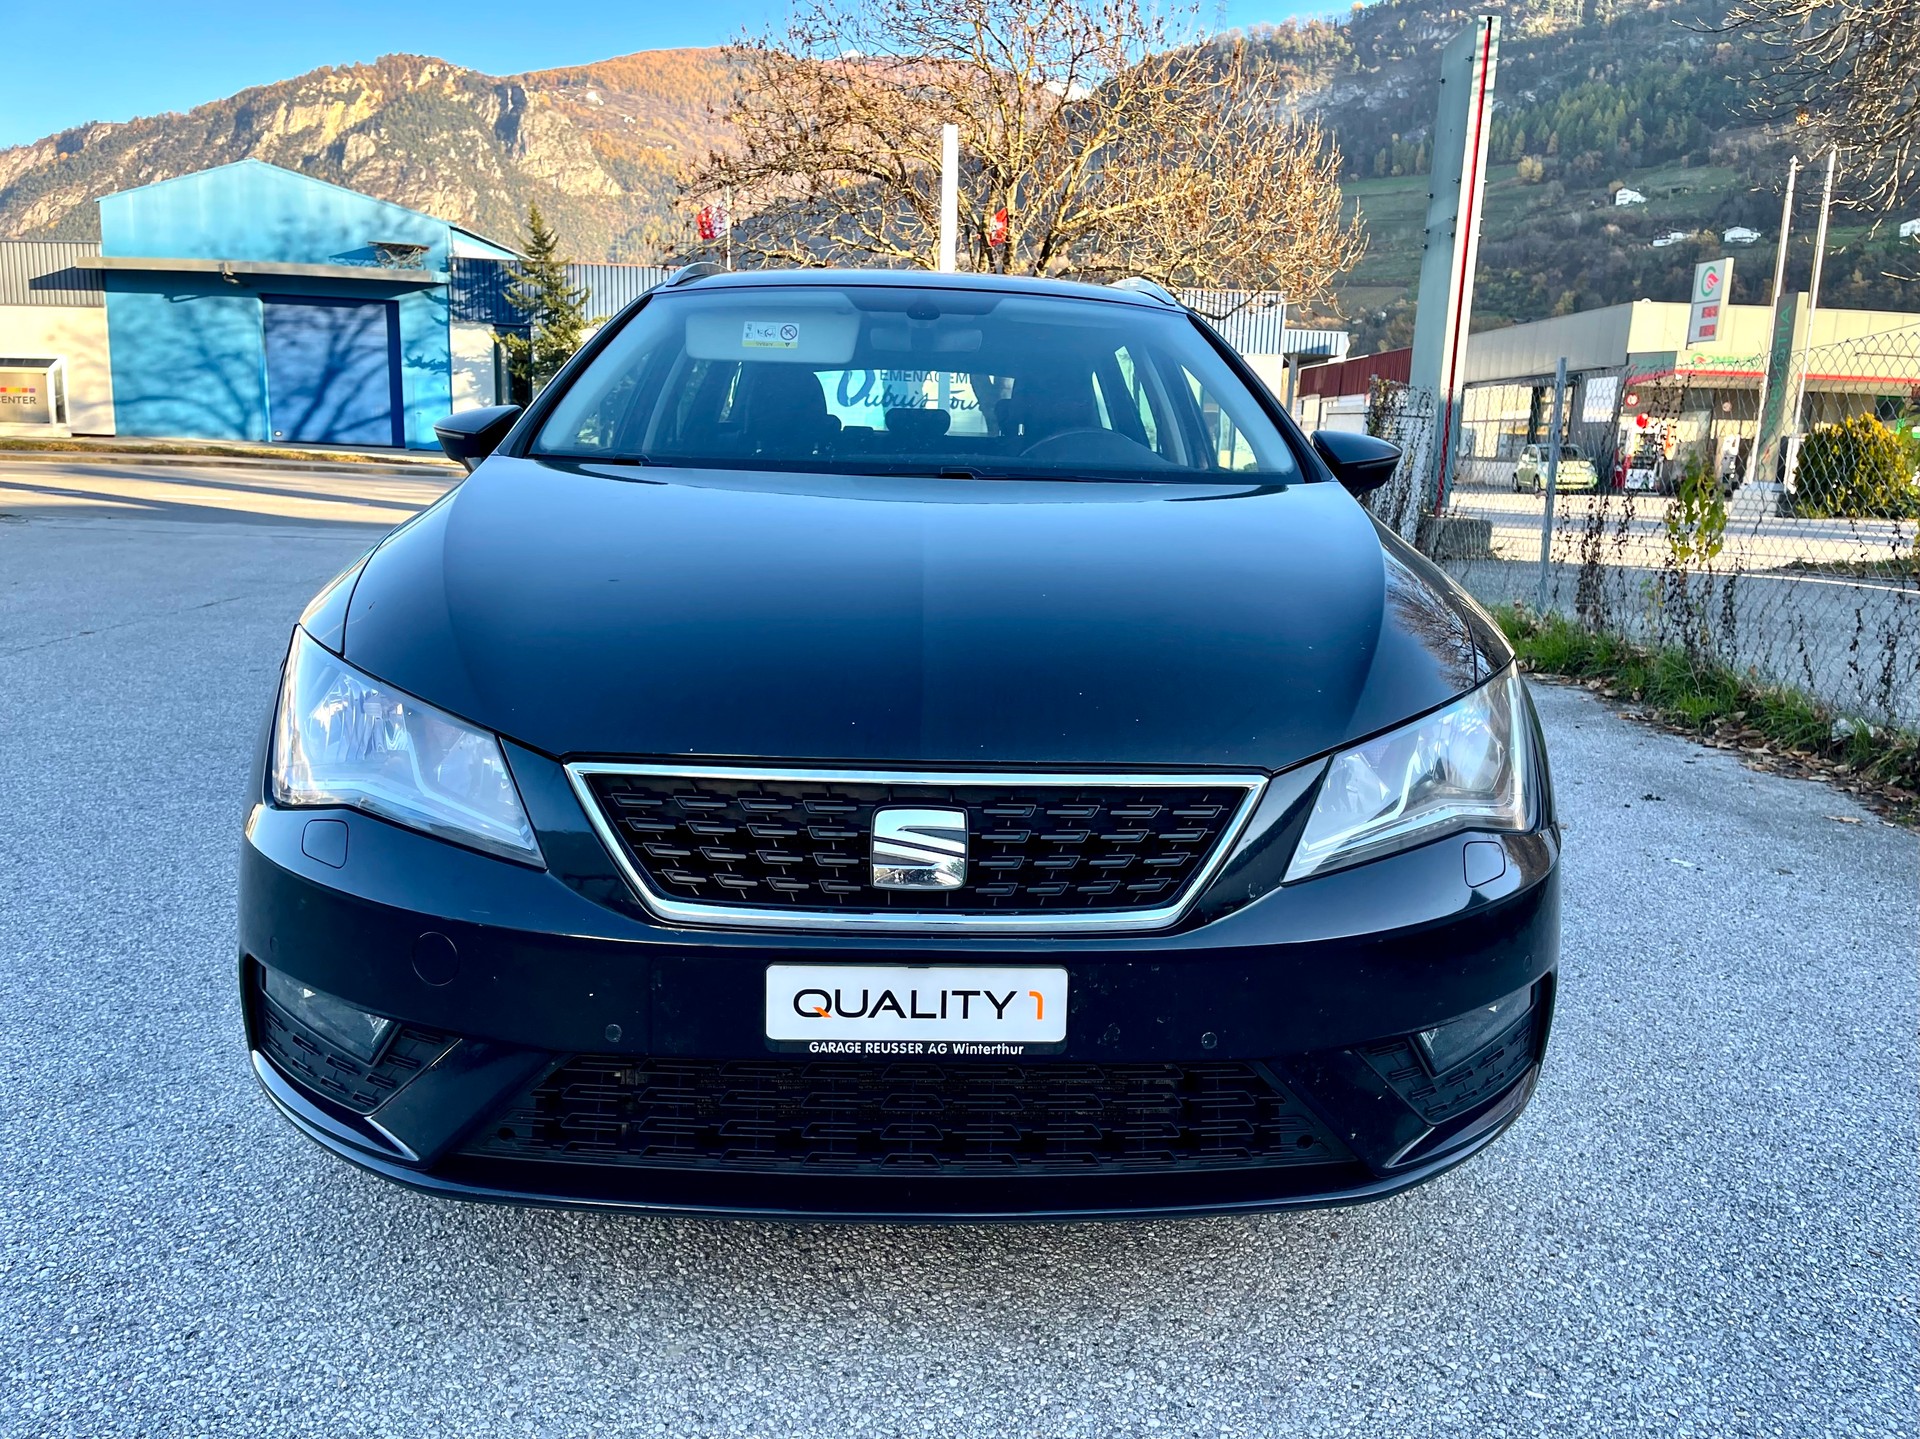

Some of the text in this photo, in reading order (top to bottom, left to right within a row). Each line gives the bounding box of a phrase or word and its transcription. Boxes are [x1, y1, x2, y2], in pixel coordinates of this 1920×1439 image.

[0, 395, 37, 405] ENTER
[793, 988, 1044, 1021] QUALITY 1
[809, 1041, 1025, 1056] GARAGE REUSSER AG Winterthur
